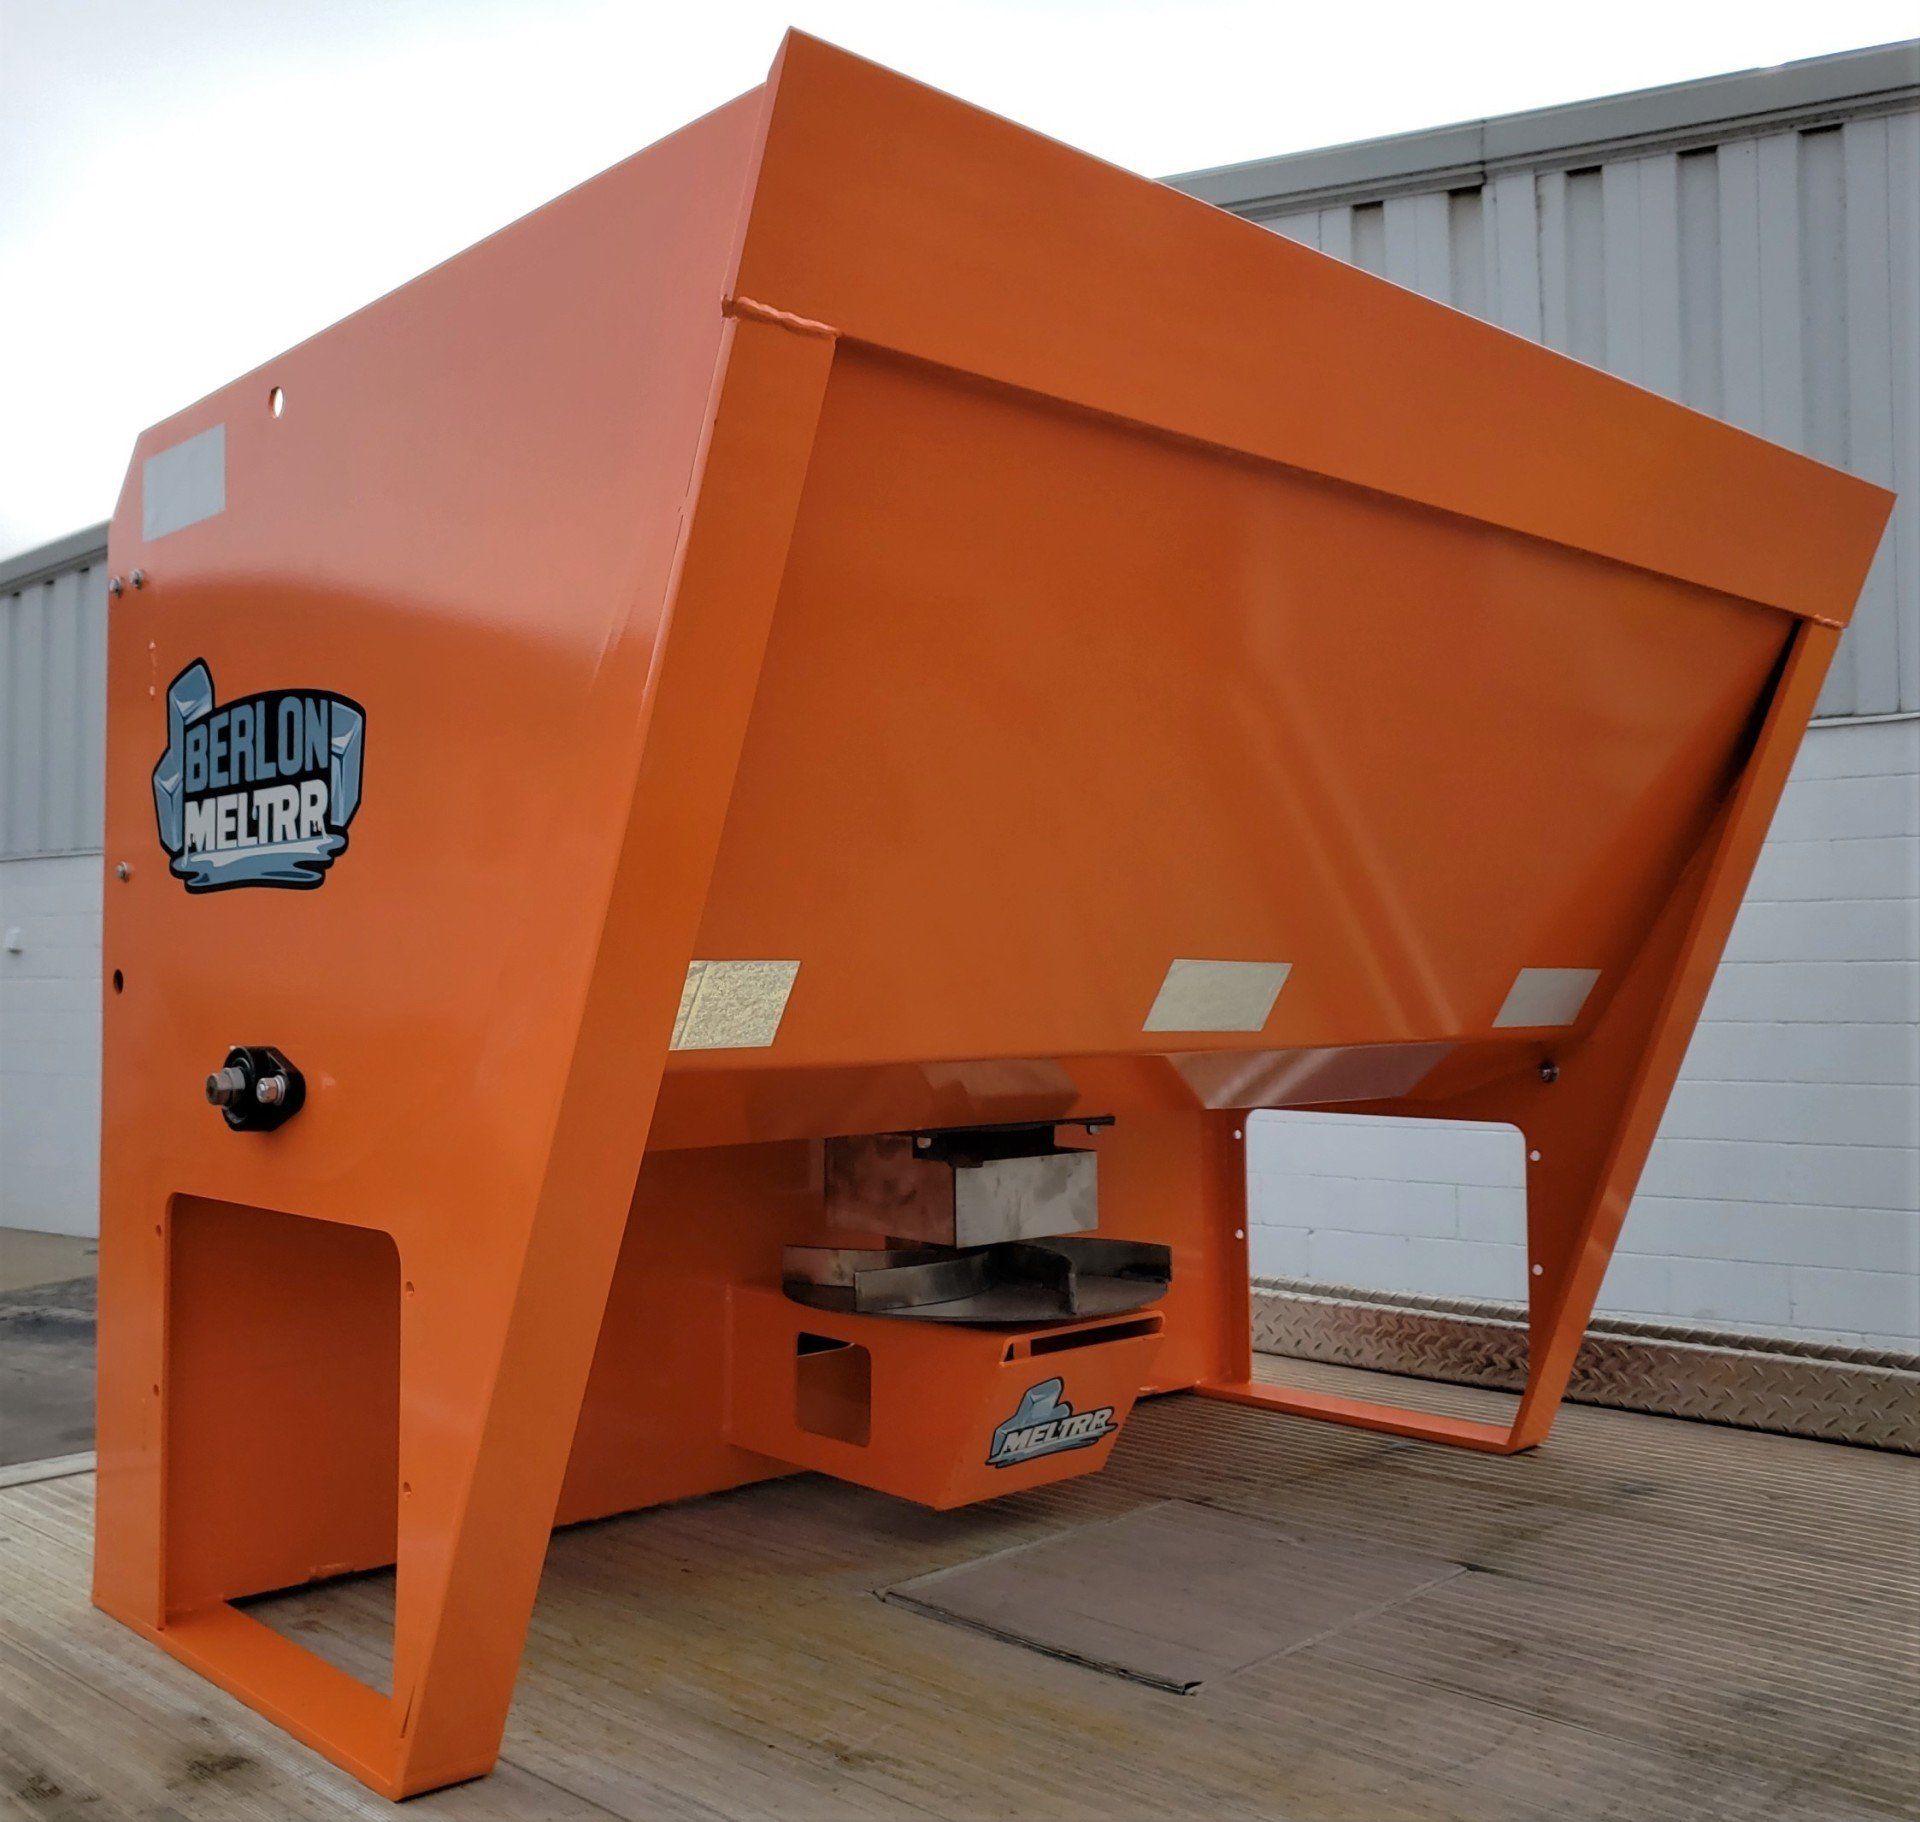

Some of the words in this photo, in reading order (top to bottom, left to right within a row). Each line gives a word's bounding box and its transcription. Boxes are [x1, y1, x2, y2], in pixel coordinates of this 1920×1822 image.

[185, 696, 328, 793] BERLON
[184, 779, 329, 853] MELTRR
[1001, 1408, 1112, 1453] MELTRR
